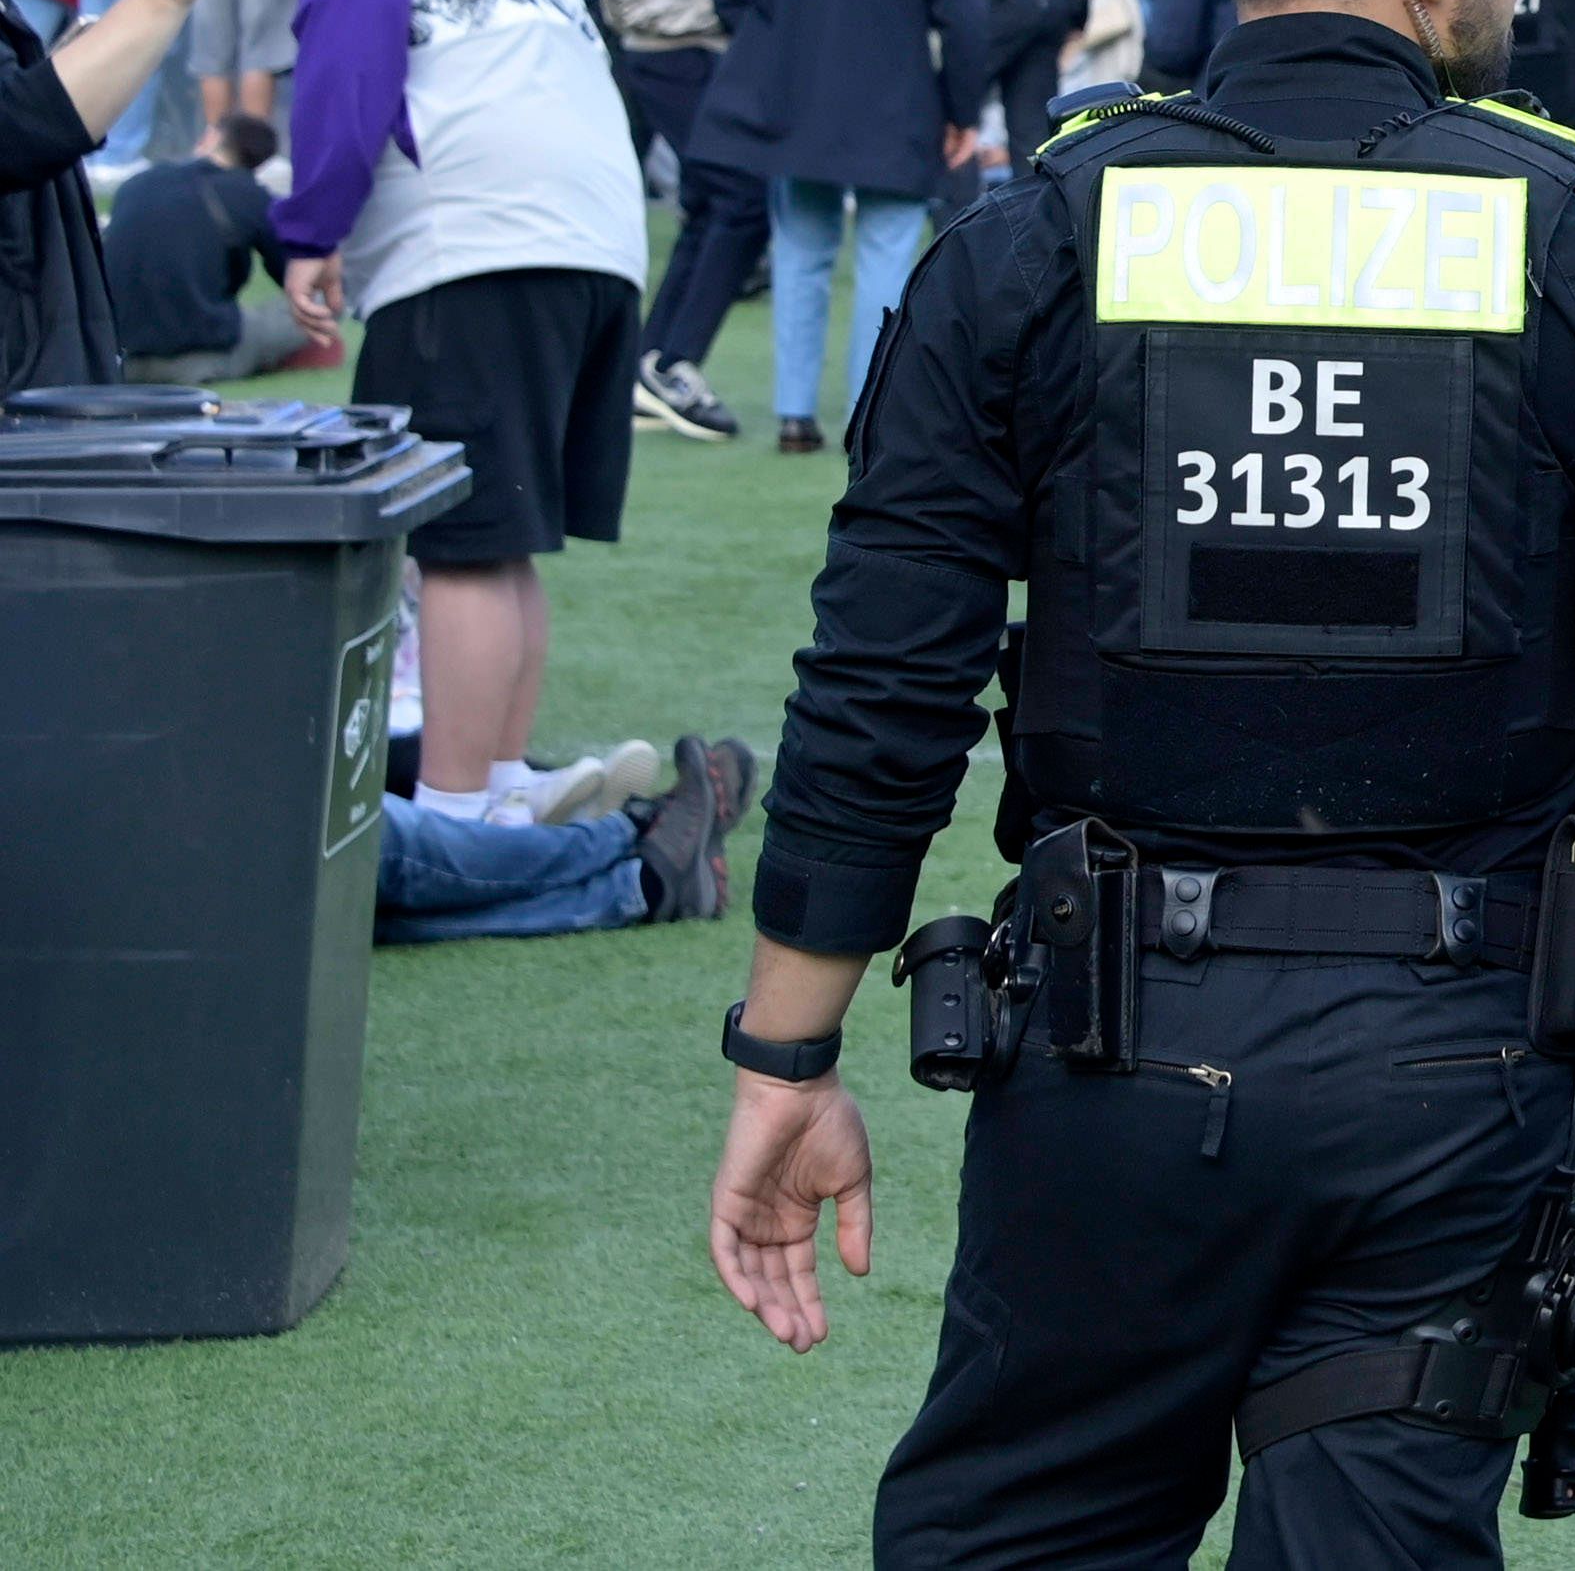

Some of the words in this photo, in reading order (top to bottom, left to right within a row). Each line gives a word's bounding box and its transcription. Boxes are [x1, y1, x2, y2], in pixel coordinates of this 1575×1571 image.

[1113, 182, 1509, 314] POLIZEI
[1251, 358, 1364, 437] BE
[1176, 450, 1431, 530] 31313
